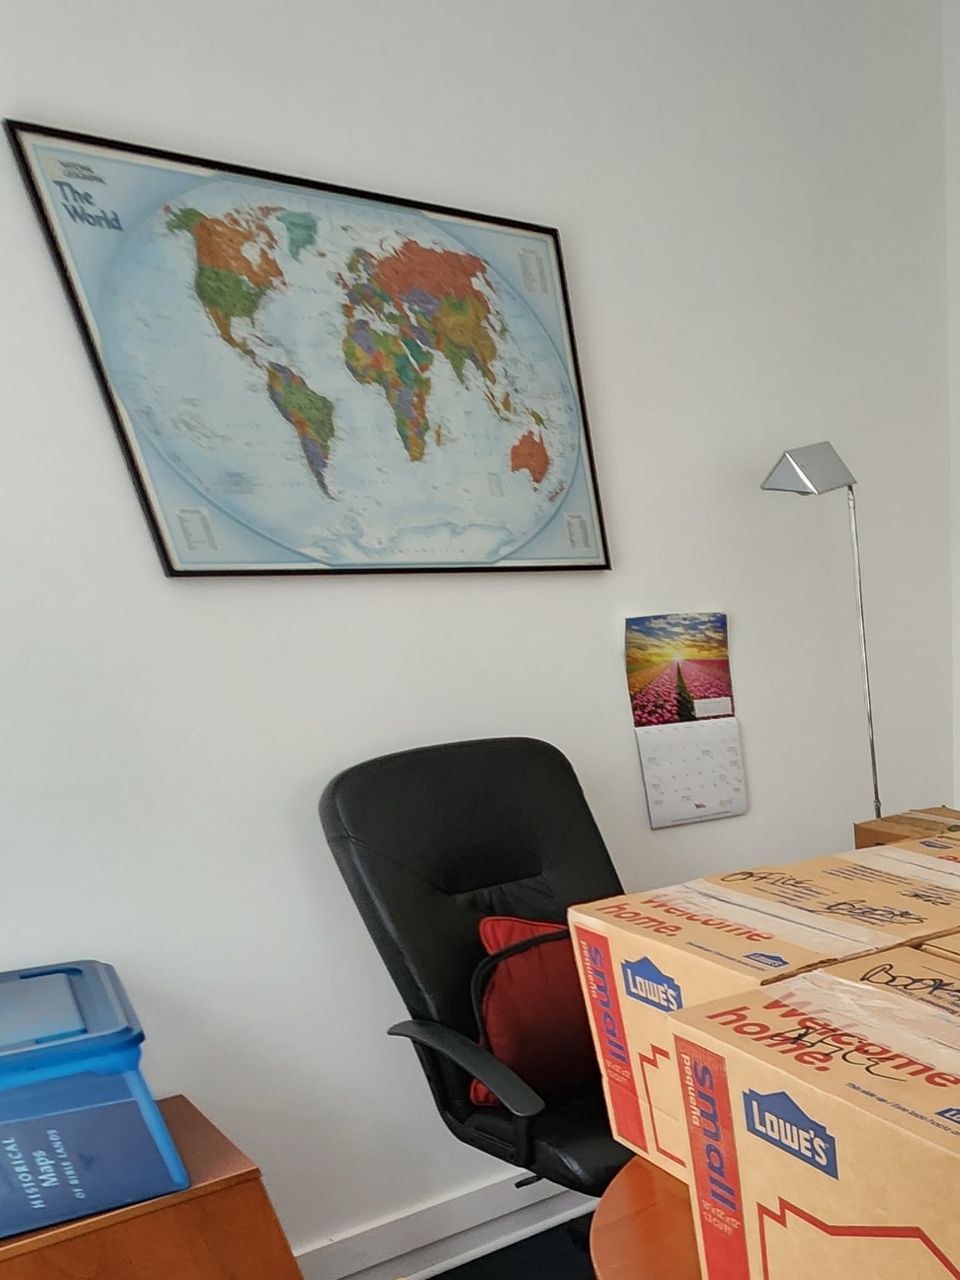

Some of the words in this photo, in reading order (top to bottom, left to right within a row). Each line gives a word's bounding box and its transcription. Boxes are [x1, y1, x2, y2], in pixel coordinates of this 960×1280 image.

[53, 180, 95, 206] The
[61, 201, 124, 232] World
[598, 902, 684, 938] home.
[641, 895, 774, 942] Welcome
[580, 941, 598, 999] pequeña
[626, 968, 678, 1011] LOWE'S
[588, 944, 628, 1064] small
[706, 1006, 833, 1072] home.
[680, 1053, 700, 1126] pequeña
[693, 1060, 737, 1211] small
[752, 1100, 828, 1166] LOWE'S
[1, 1136, 46, 1210] HISTORICAL
[32, 1150, 60, 1188] Maps
